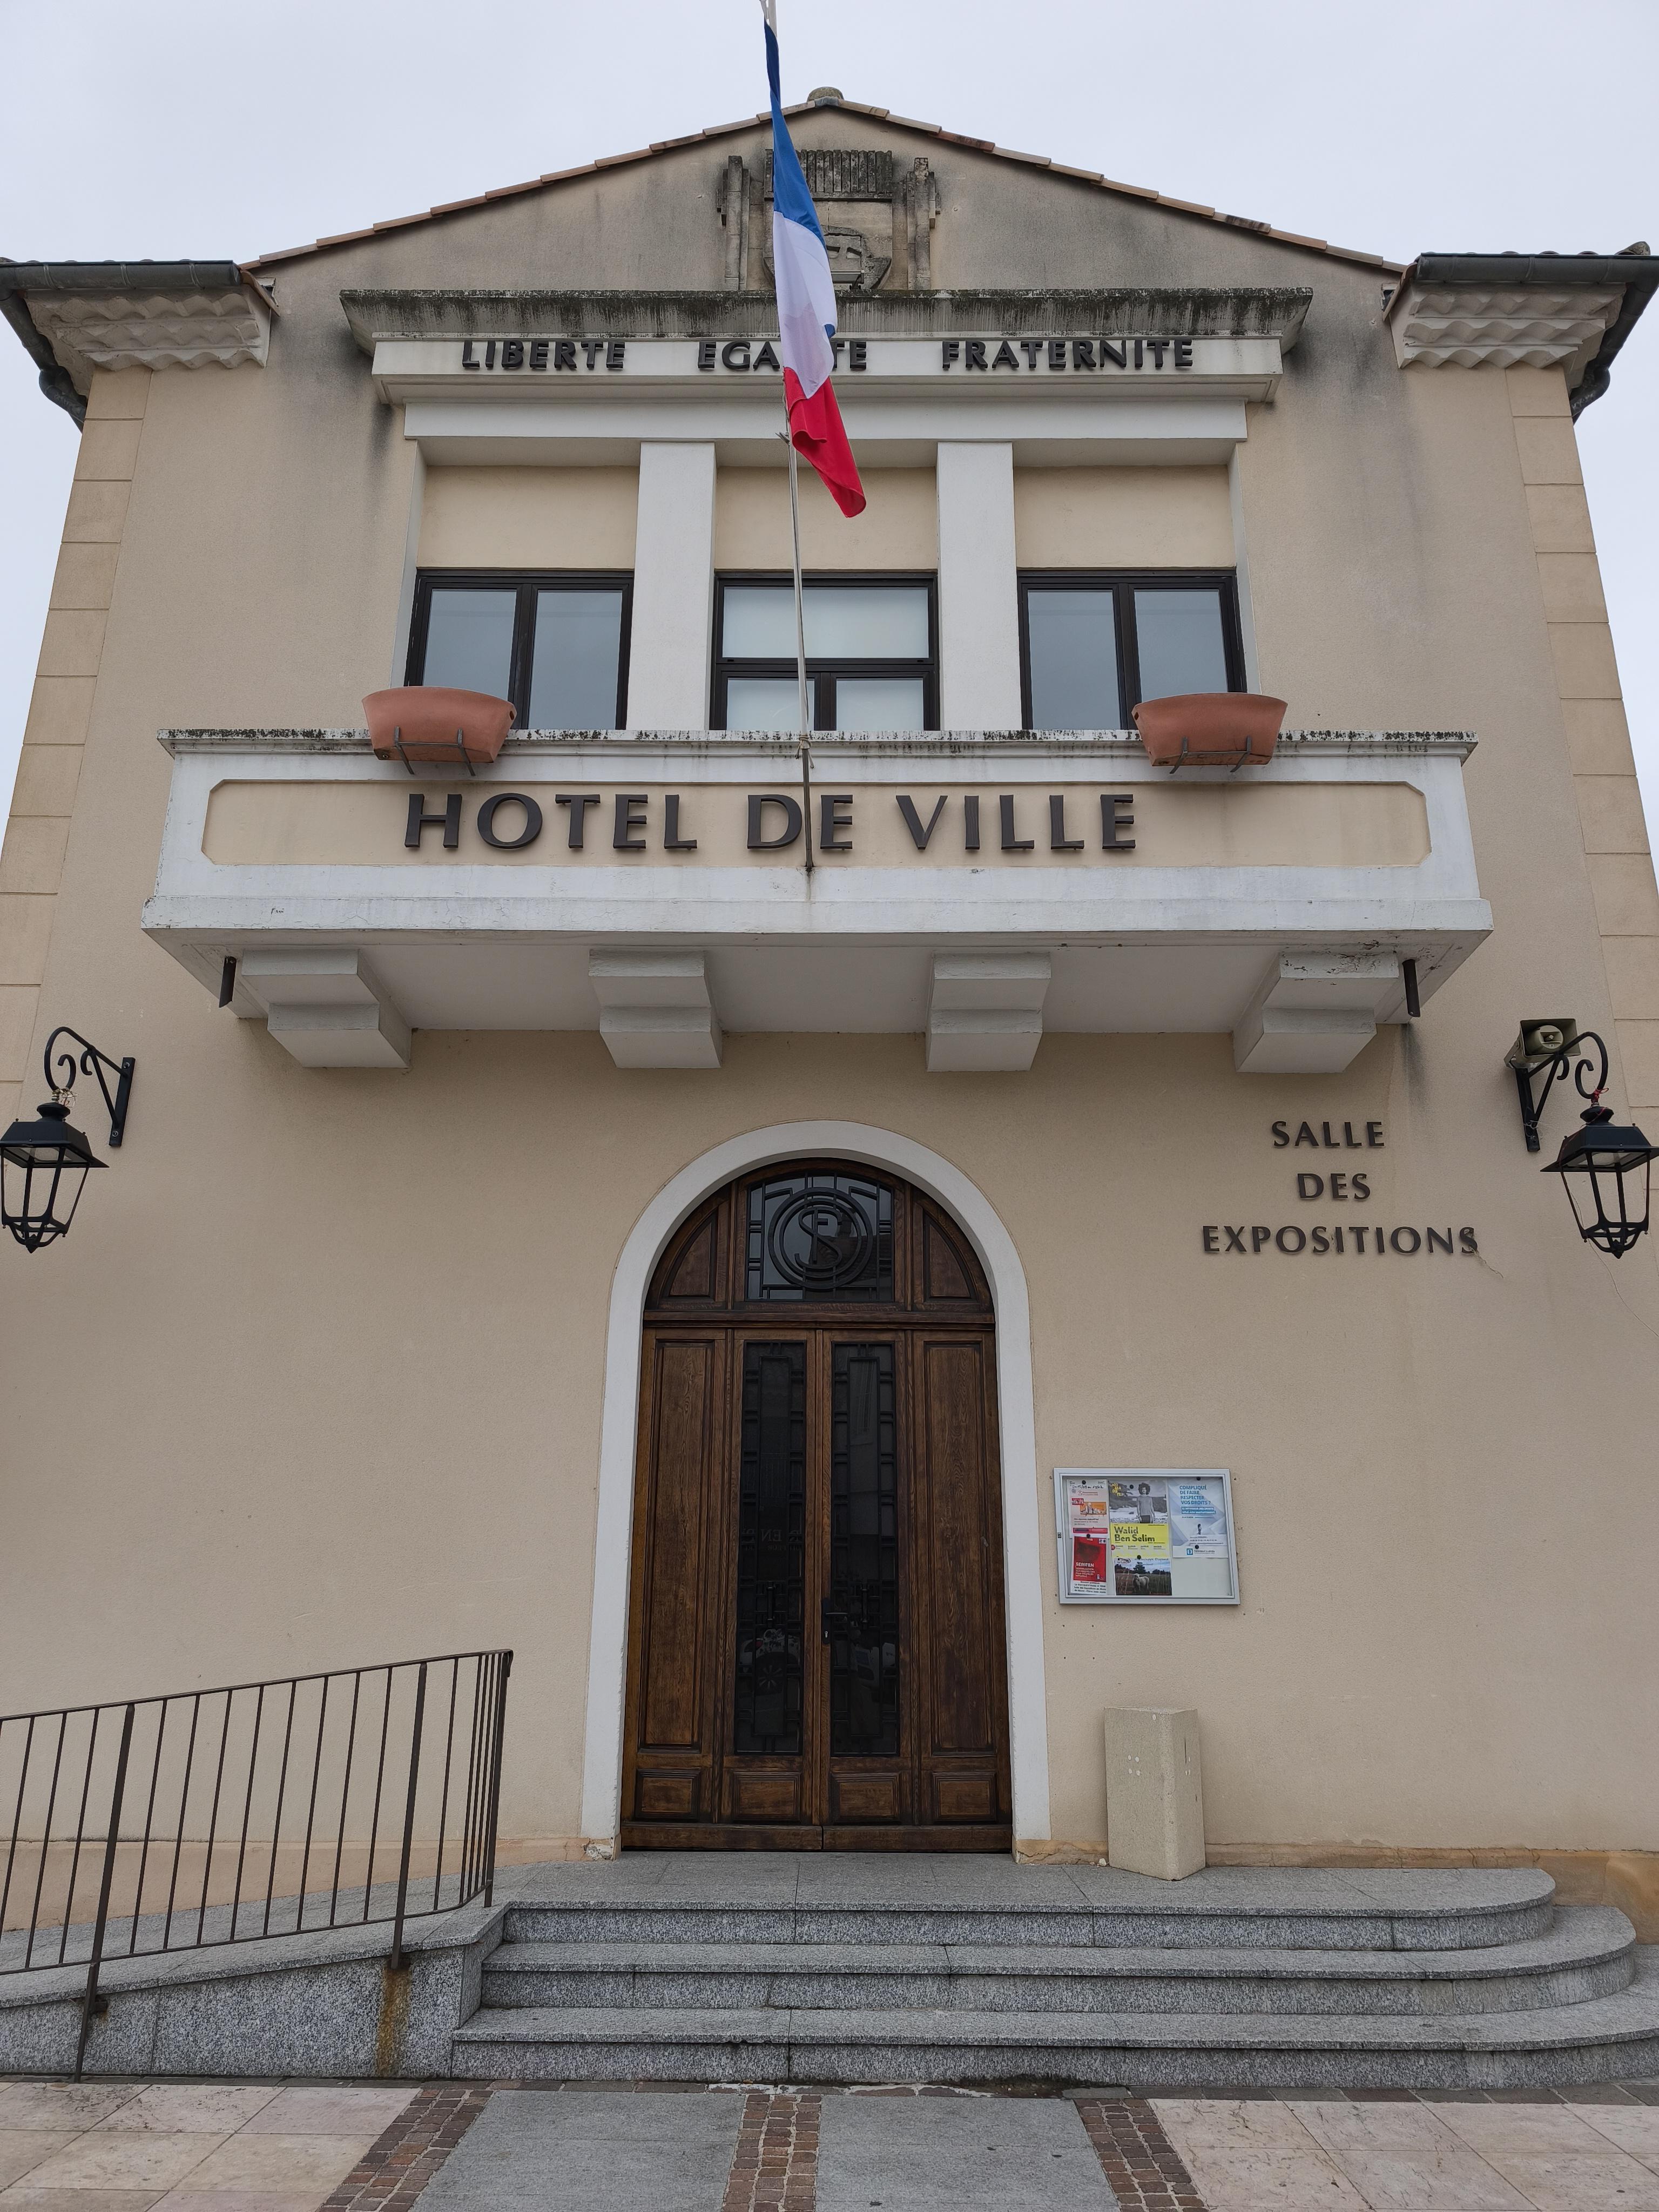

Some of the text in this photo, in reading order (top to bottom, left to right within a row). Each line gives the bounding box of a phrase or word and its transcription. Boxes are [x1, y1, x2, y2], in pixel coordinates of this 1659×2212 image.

[462, 339, 1192, 369] LIBERTE EGATE FRATERNITE
[404, 793, 1136, 850] HOTEL DE VILLE
[1271, 1121, 1385, 1147] SALLE
[1297, 1173, 1371, 1200] DES
[1202, 1225, 1479, 1254] EXPOSITIONS
